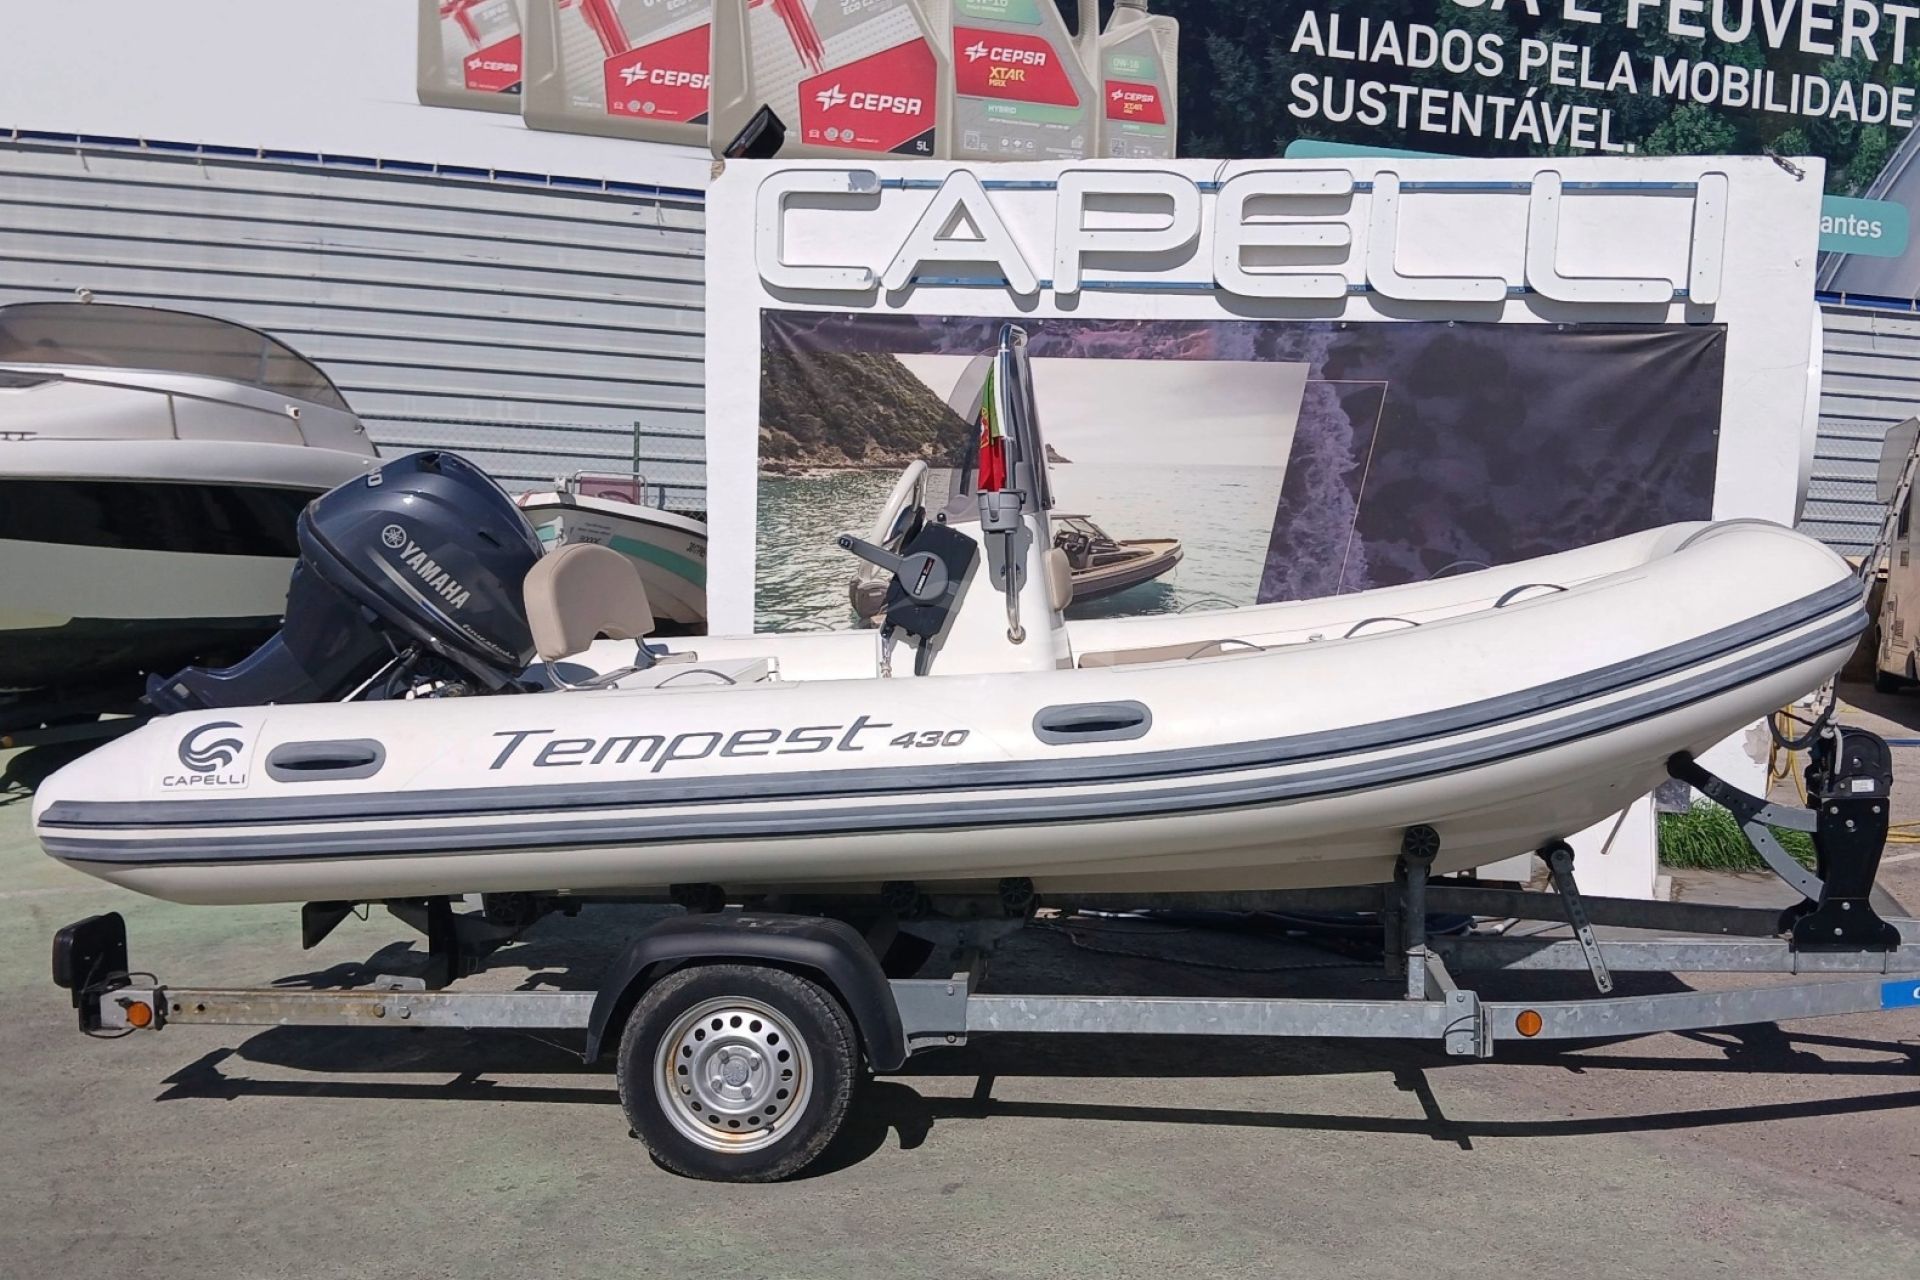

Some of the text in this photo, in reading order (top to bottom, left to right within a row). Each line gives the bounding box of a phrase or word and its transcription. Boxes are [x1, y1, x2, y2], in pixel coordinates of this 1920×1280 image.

[989, 66, 1025, 81] XTAR
[990, 47, 1046, 66] CEPSA
[1289, 10, 1916, 128] ALIADOS PELA MOBILIDADE
[849, 92, 922, 115] CEPSA
[1287, 73, 1636, 154] SUSTENTÁVEL.
[916, 141, 930, 151] 5L
[754, 168, 1729, 305] CAPELLI
[400, 540, 471, 609] YAMAHA
[488, 714, 971, 774] Tempest 430
[162, 774, 246, 787] CAPELLI
